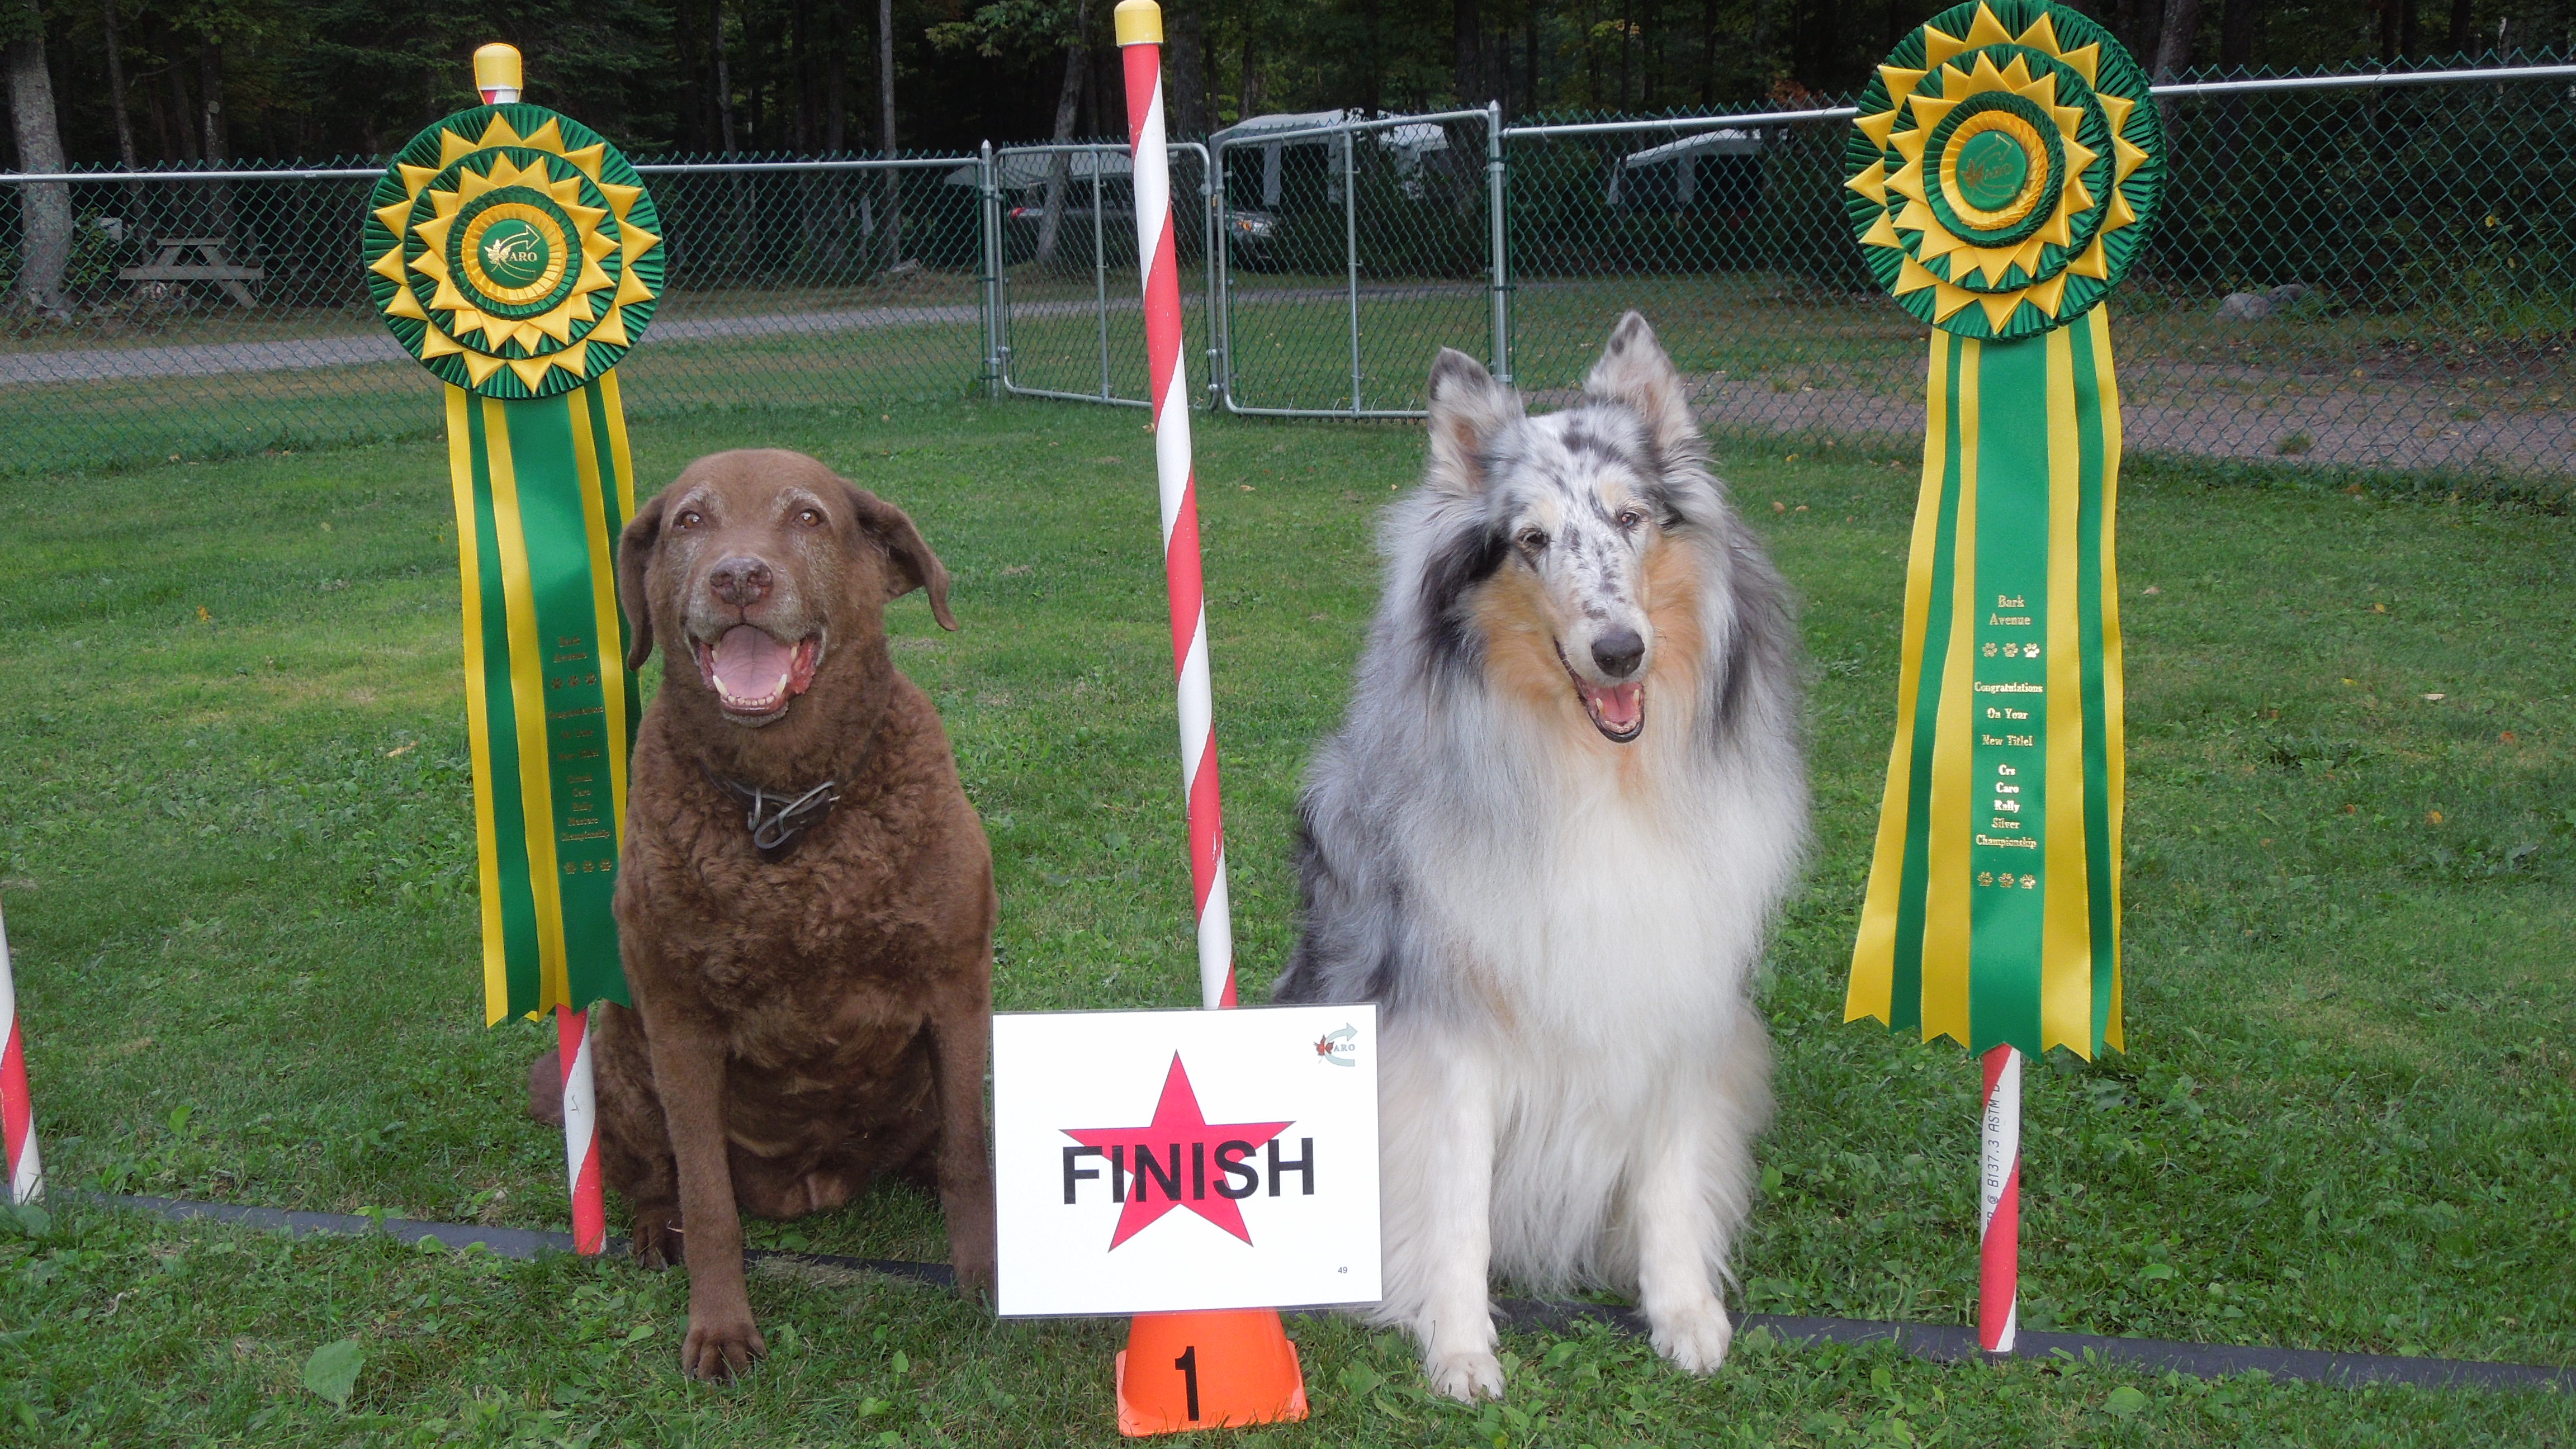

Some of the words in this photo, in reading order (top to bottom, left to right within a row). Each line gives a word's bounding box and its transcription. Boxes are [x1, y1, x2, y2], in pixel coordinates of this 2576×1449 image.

[1998, 595, 2025, 608] Bark
[1990, 613, 2032, 625] Avenue
[1974, 681, 2043, 694] Congratulations
[1987, 708, 2001, 718] On
[1982, 735, 2003, 746] New
[2007, 735, 2033, 746] Title!
[1996, 782, 2019, 793] Caro
[1993, 799, 2020, 813] Rally
[1991, 817, 2020, 829] Silver
[1976, 834, 2037, 849] Championship
[1988, 1099, 2000, 1133] ASTM
[1987, 1139, 2000, 1187] B137.3
[1062, 1138, 1315, 1205] FINISH
[1175, 1346, 1200, 1422] 1
